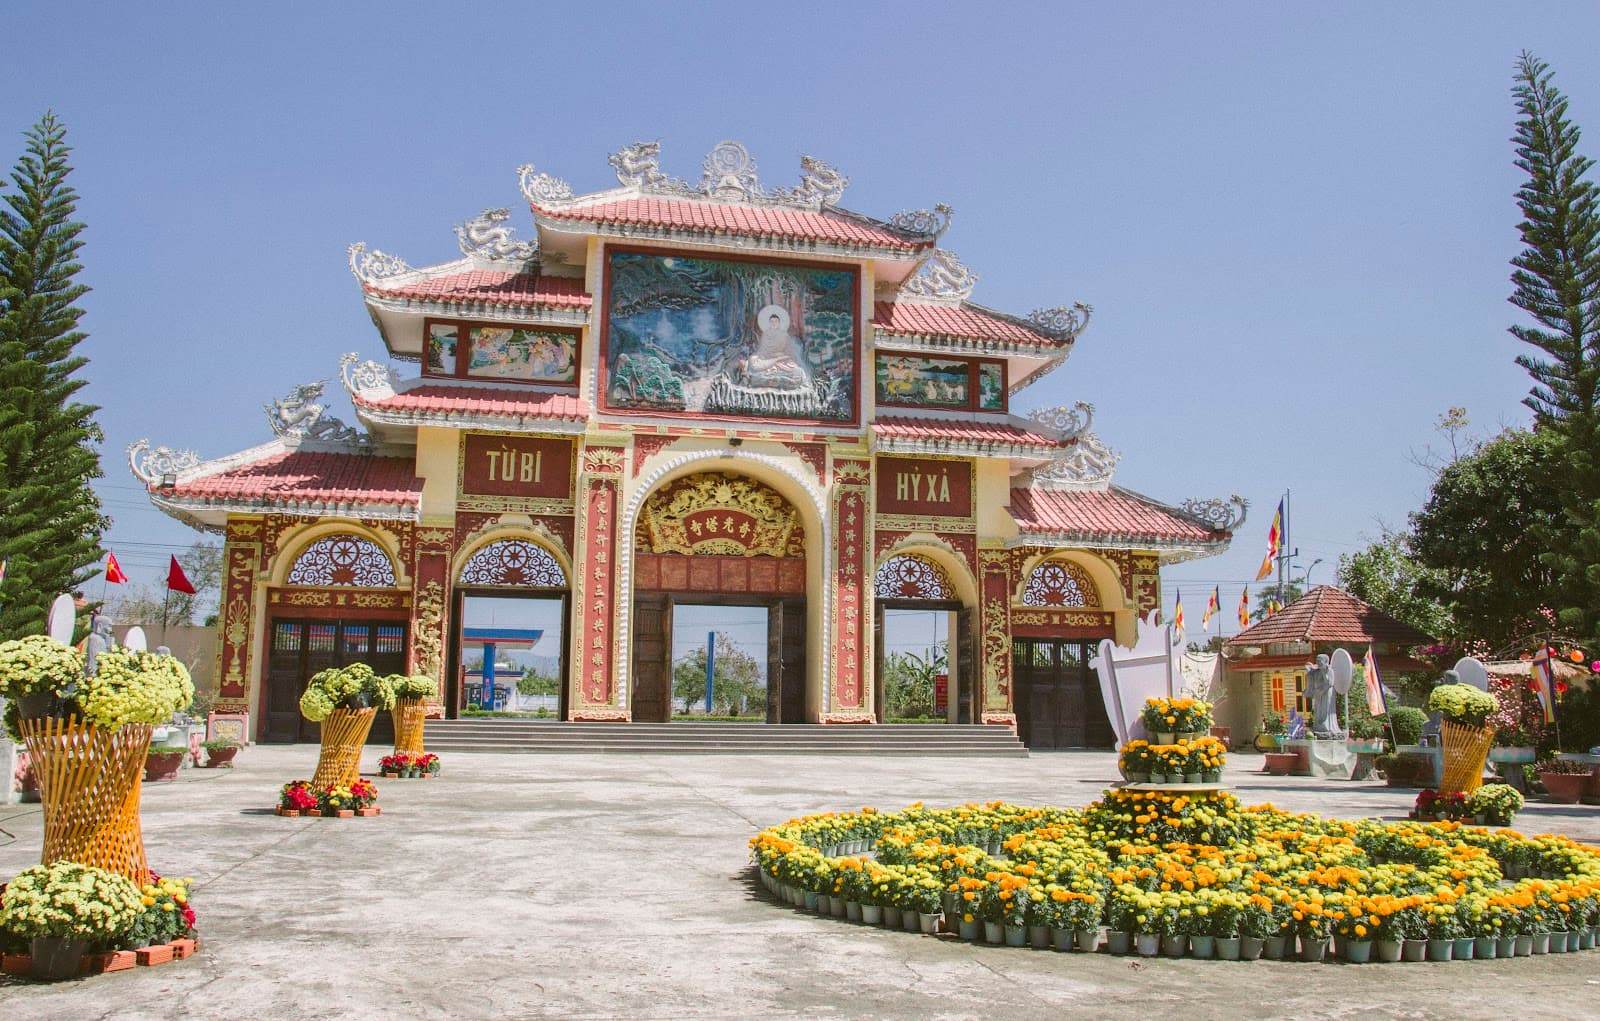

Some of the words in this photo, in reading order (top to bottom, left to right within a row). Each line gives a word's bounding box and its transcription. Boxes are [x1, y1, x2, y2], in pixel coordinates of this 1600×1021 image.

[486, 444, 517, 481] TỪ
[896, 466, 922, 501] HỶ
[926, 467, 951, 502] XẢ
